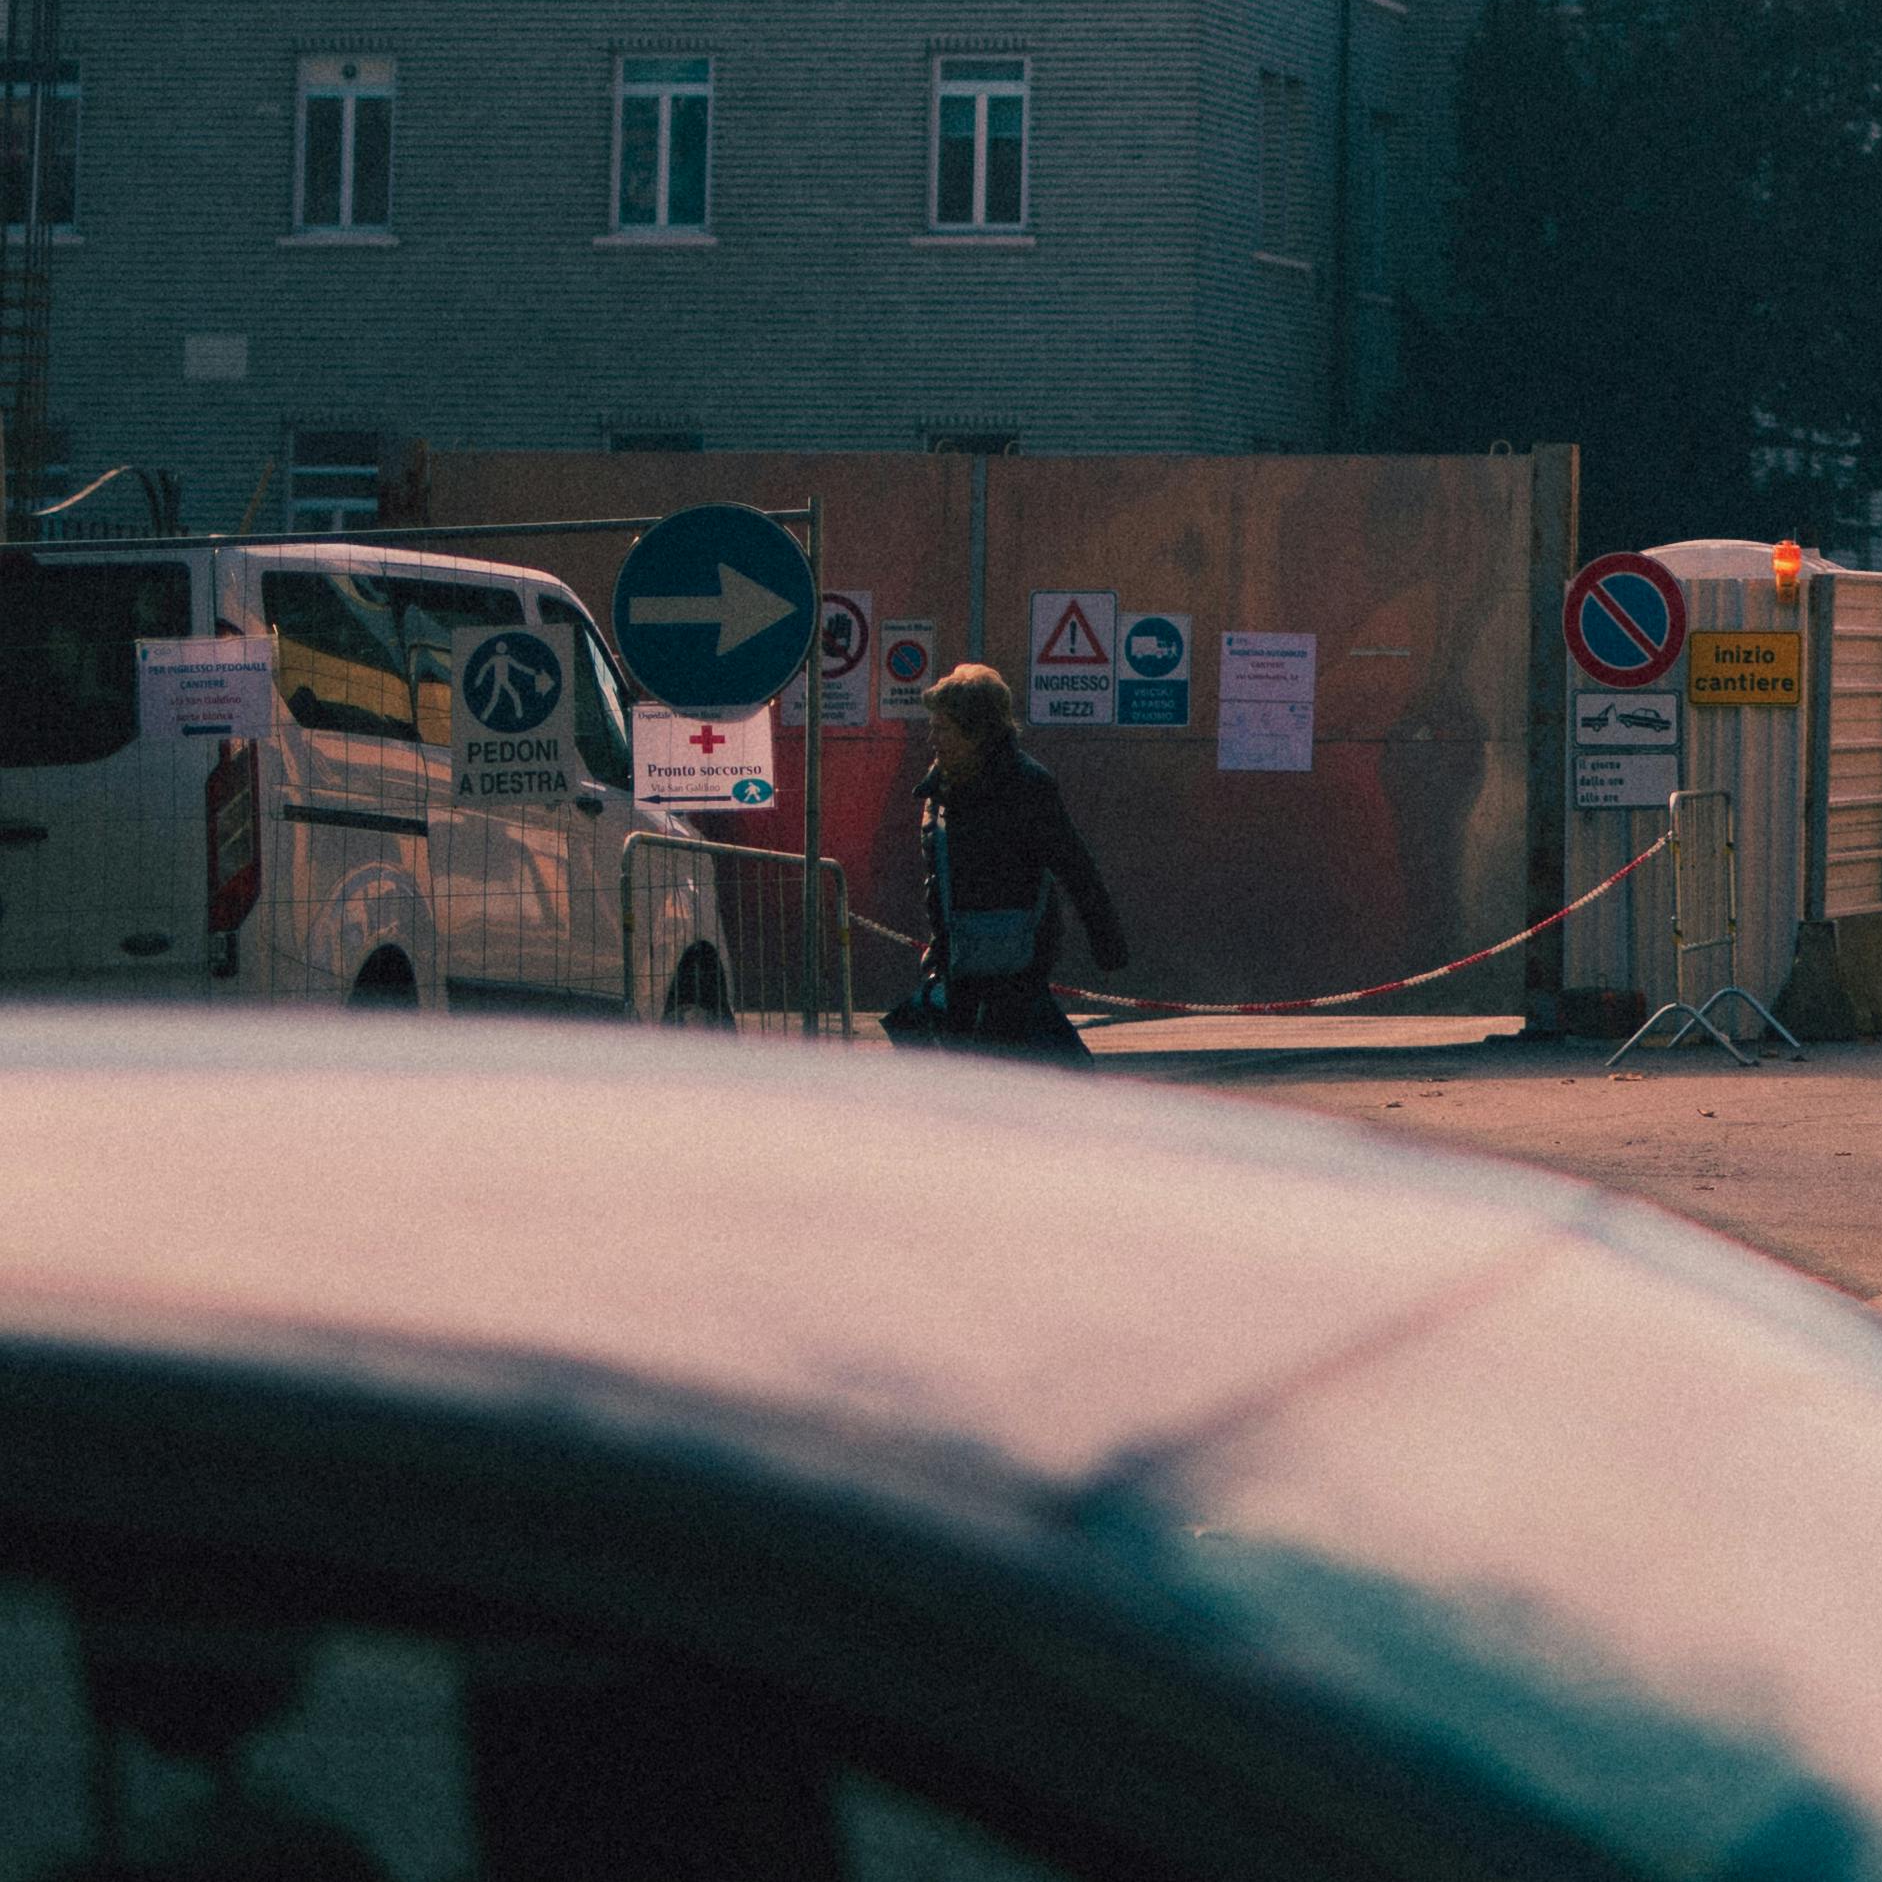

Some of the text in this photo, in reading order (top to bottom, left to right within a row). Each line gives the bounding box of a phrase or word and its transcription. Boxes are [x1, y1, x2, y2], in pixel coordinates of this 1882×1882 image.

[1714, 644, 1776, 664] inizio
[1034, 675, 1110, 692] INGRESSO
[1694, 674, 1794, 693] cantiere
[1048, 701, 1094, 717] MEZZI
[467, 739, 559, 764] PEDONI
[647, 763, 762, 778] Pronto soccorso
[459, 770, 568, 795] A DESTRA
